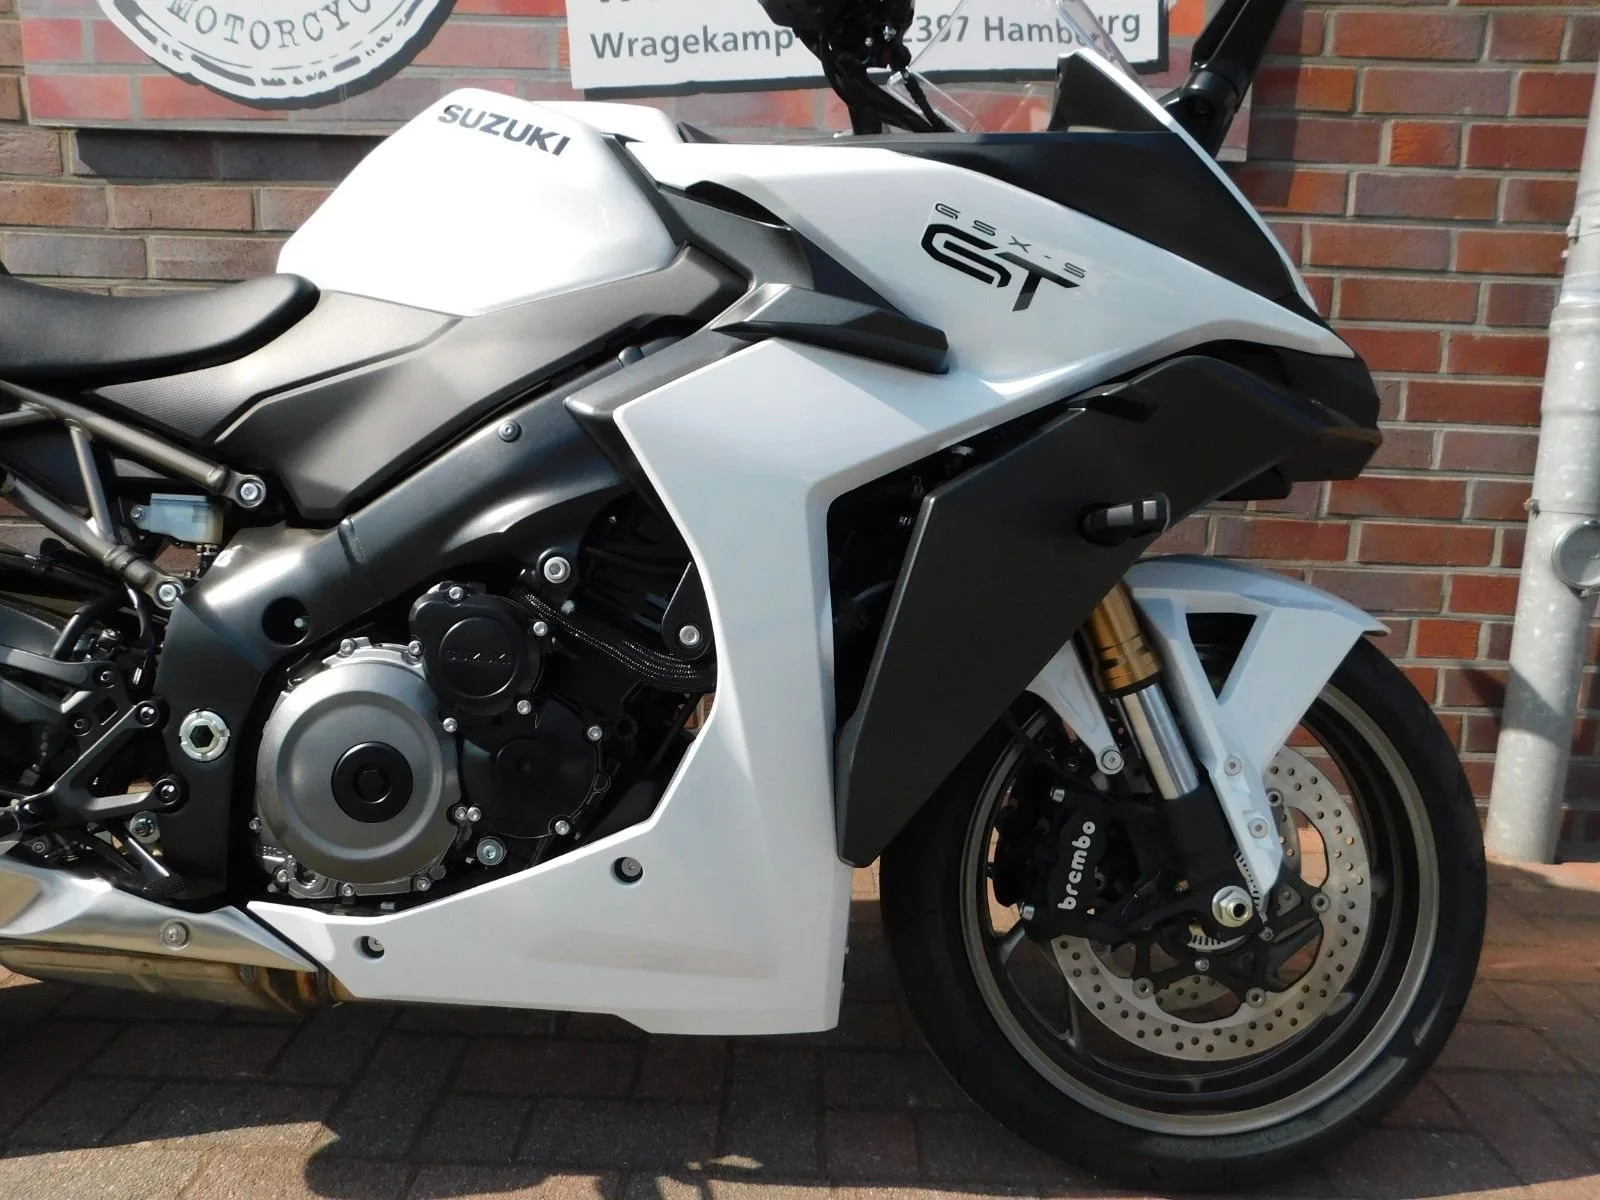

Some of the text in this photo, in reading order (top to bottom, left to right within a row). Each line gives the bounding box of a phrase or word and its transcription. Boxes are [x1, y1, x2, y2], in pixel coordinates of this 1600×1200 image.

[590, 25, 794, 63] Wragekamp
[902, 14, 969, 43] 397
[438, 104, 571, 156] SUZUKI
[920, 223, 1081, 312] GT
[1057, 821, 1096, 910] brembo
